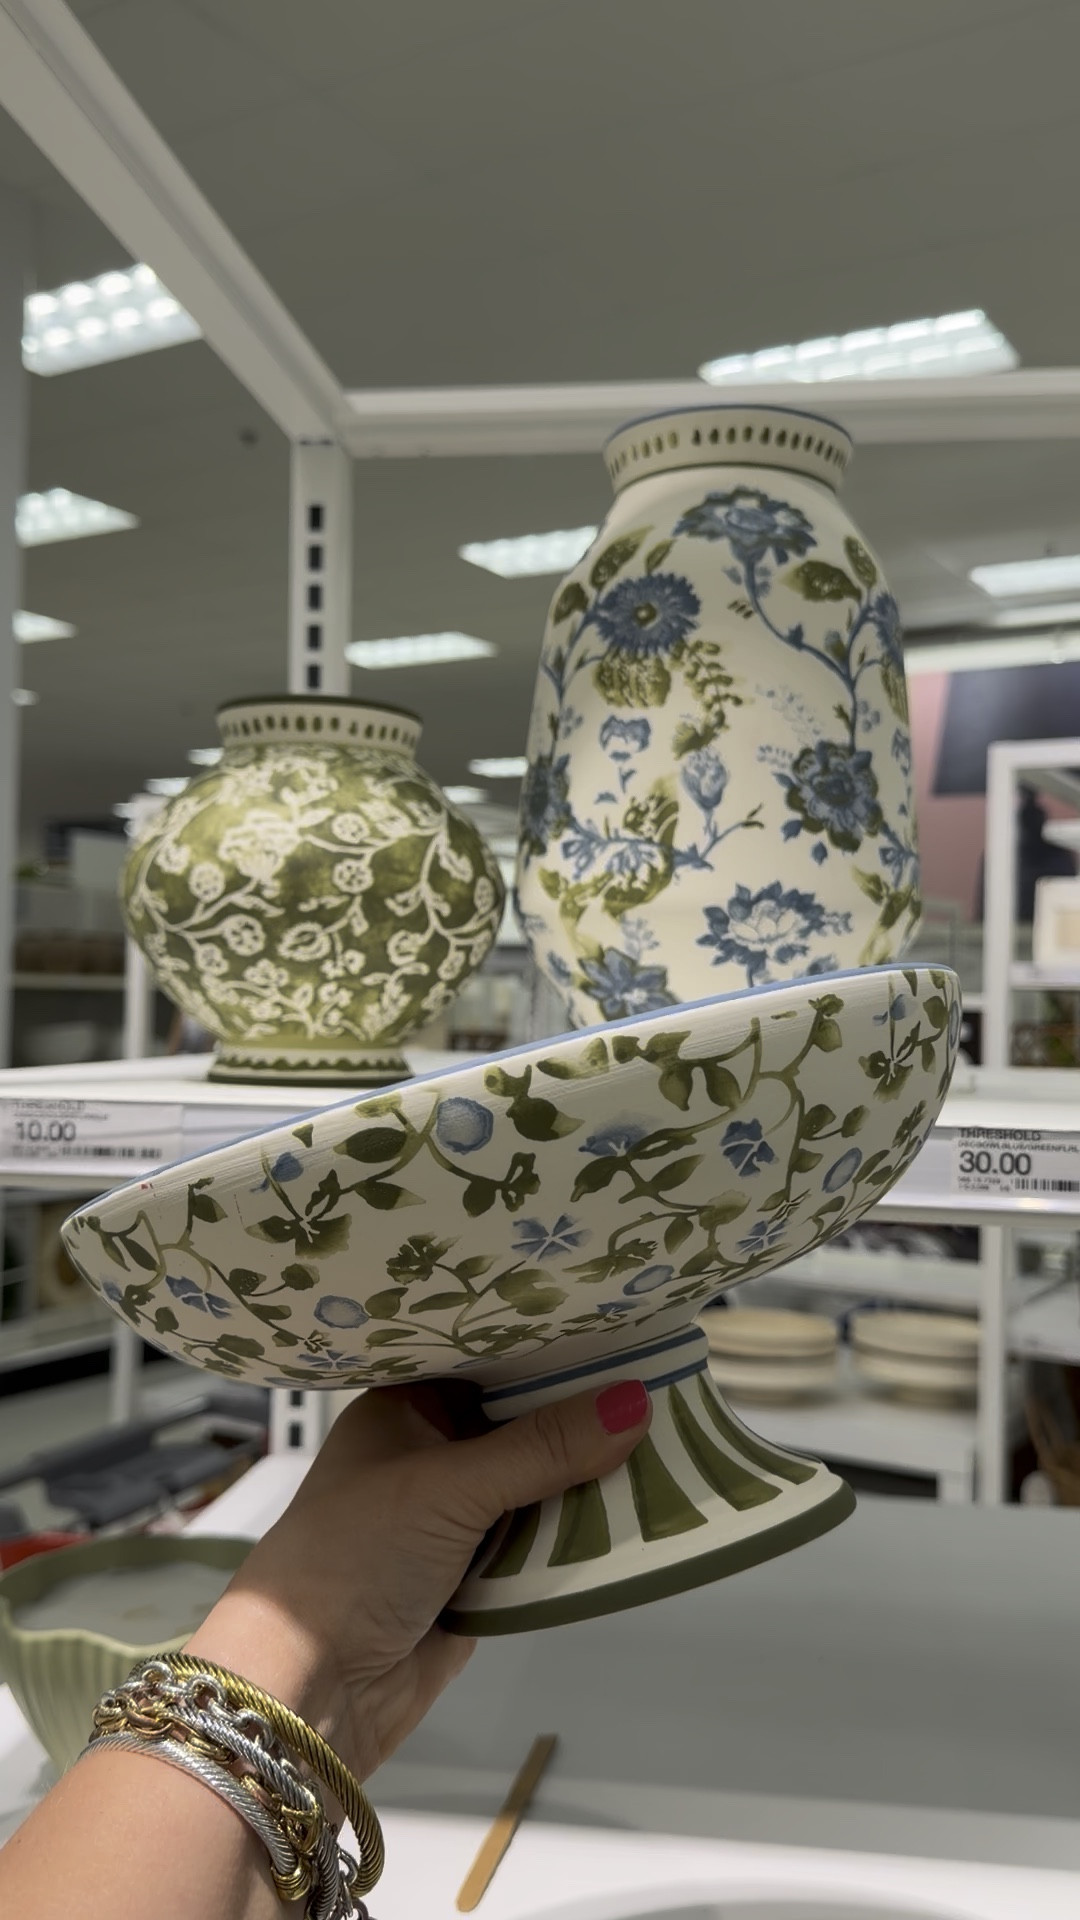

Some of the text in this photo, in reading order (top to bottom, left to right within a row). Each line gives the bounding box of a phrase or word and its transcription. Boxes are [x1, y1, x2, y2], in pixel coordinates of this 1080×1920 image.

[15, 1120, 76, 1141] 10.00
[959, 1128, 1041, 1141] THRESHOLD
[959, 1150, 1031, 1175] 30.00
